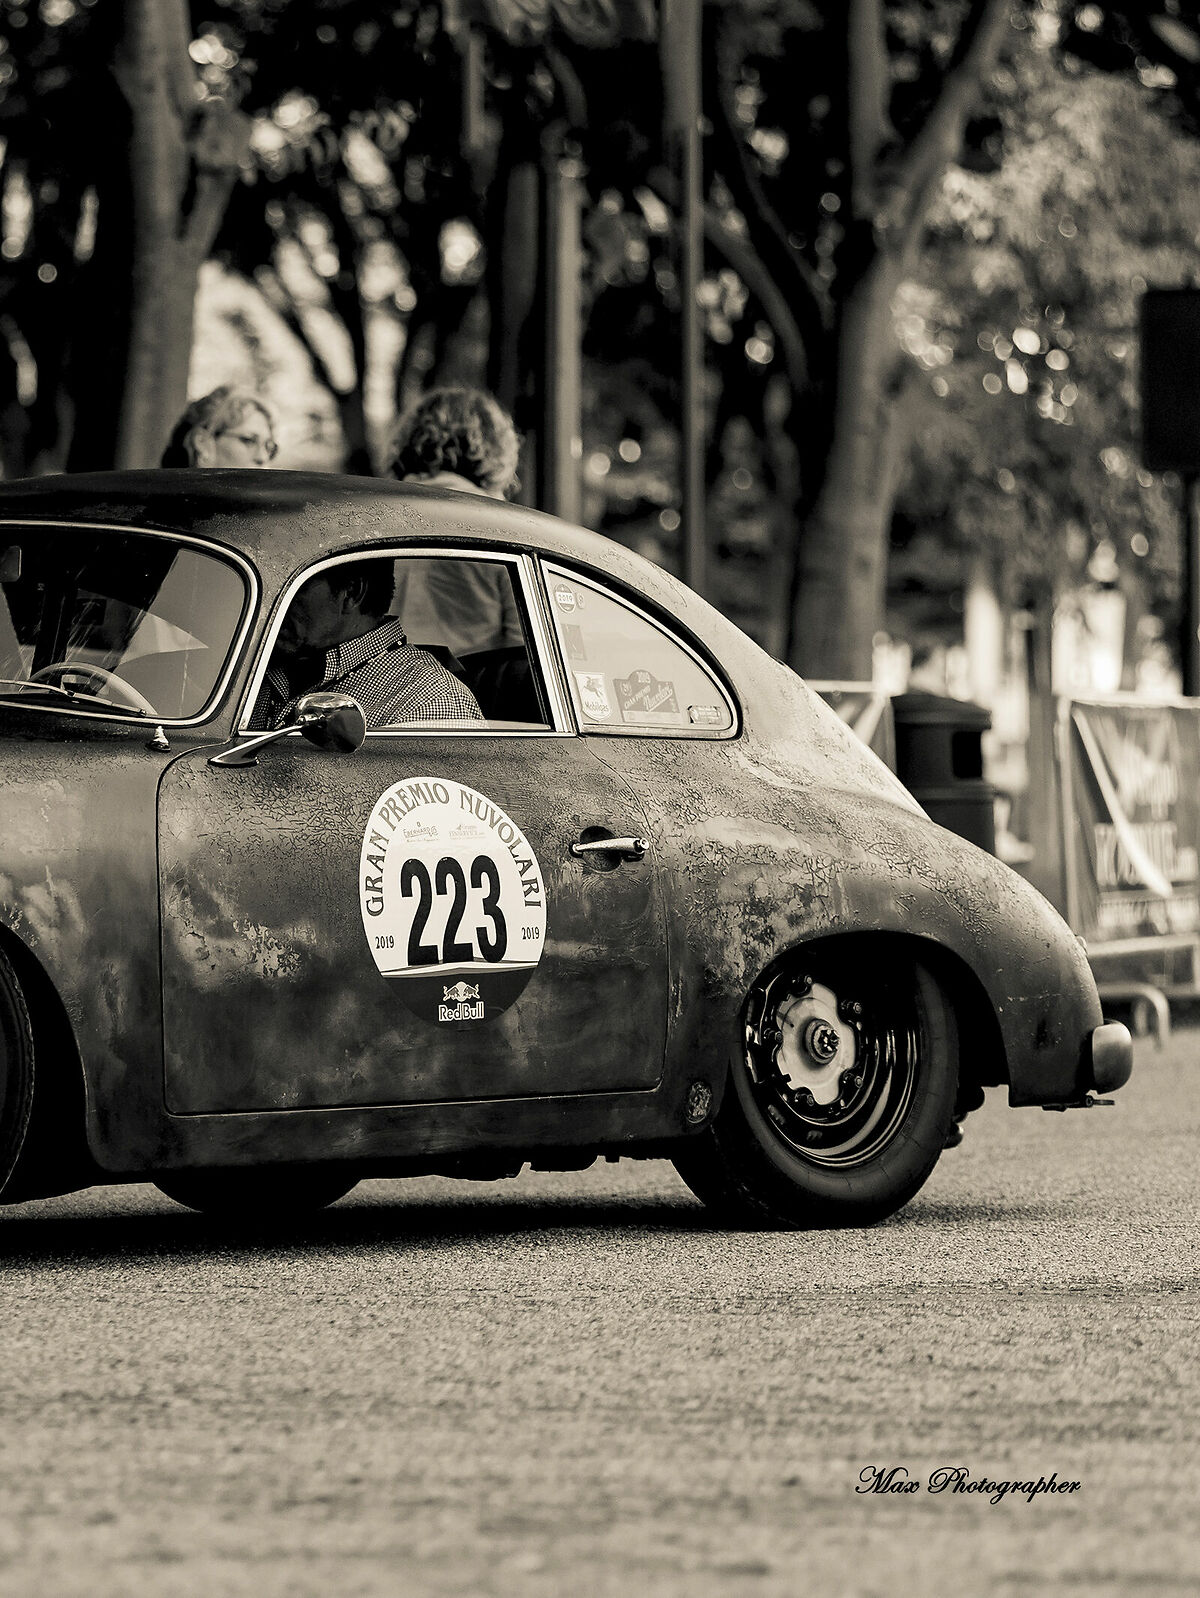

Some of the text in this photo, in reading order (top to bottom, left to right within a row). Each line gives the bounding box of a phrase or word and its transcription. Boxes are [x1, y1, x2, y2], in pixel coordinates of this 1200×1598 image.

[365, 782, 542, 917] GRAN PREMIO NUVOLARI
[400, 854, 508, 966] 223
[522, 926, 540, 940] 2019
[375, 935, 395, 949] 2019
